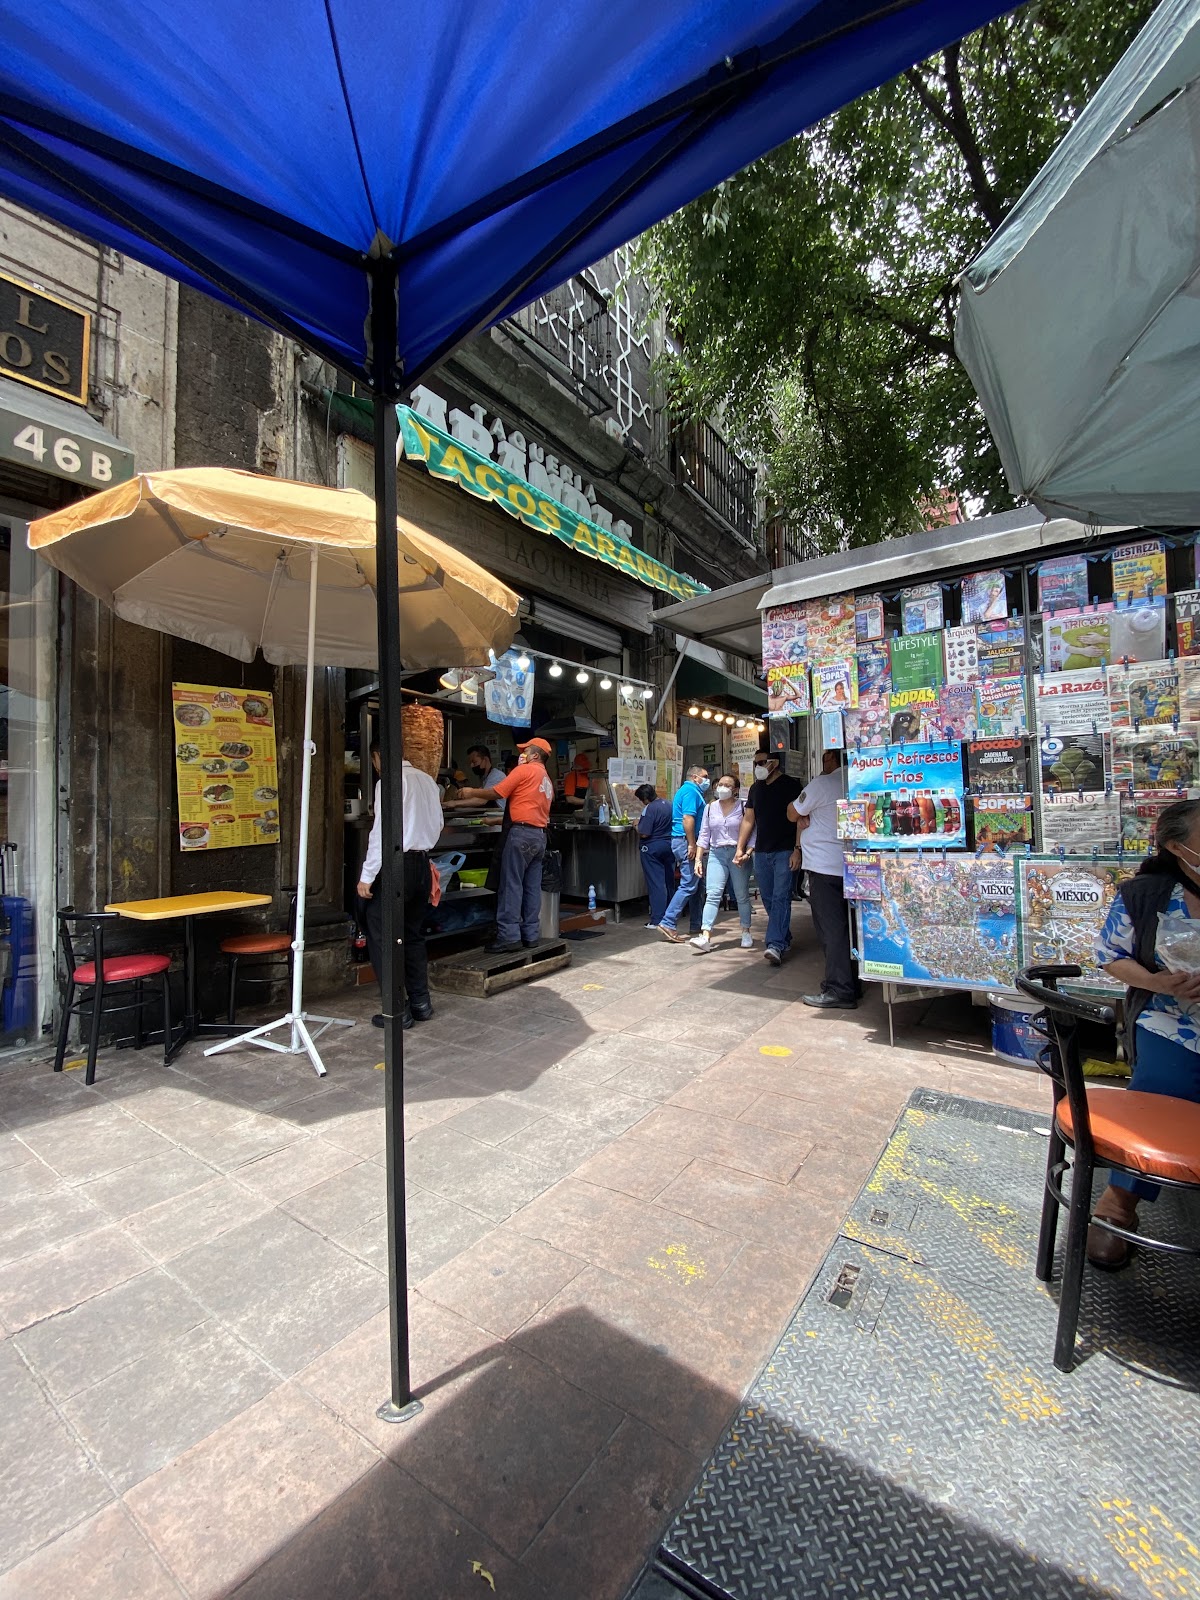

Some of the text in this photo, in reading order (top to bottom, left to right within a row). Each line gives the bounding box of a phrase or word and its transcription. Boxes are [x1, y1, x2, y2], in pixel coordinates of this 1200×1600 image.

[16, 293, 48, 334] L
[470, 403, 597, 503] TAQUERIA
[408, 418, 695, 600] TACOS ARANDAS
[903, 581, 940, 598] SOPAS
[855, 592, 881, 606] OPAS
[1176, 603, 1200, 617] Y P
[894, 635, 939, 652] LIFESTYLE
[768, 663, 806, 682] SOPAS
[821, 671, 846, 682] SOPAS
[891, 688, 936, 707] SOPAS
[978, 687, 1004, 697] Super
[1038, 685, 1059, 697] La
[623, 725, 632, 747] 3
[970, 739, 1022, 754] proceso
[851, 751, 960, 771] Aguas y Refrescos
[883, 769, 924, 785] Fríos
[978, 798, 1026, 811] SOPAS
[1043, 794, 1095, 805] MILENIO
[981, 883, 1015, 895] MÉXIC
[1056, 889, 1099, 903] MÉXICO
